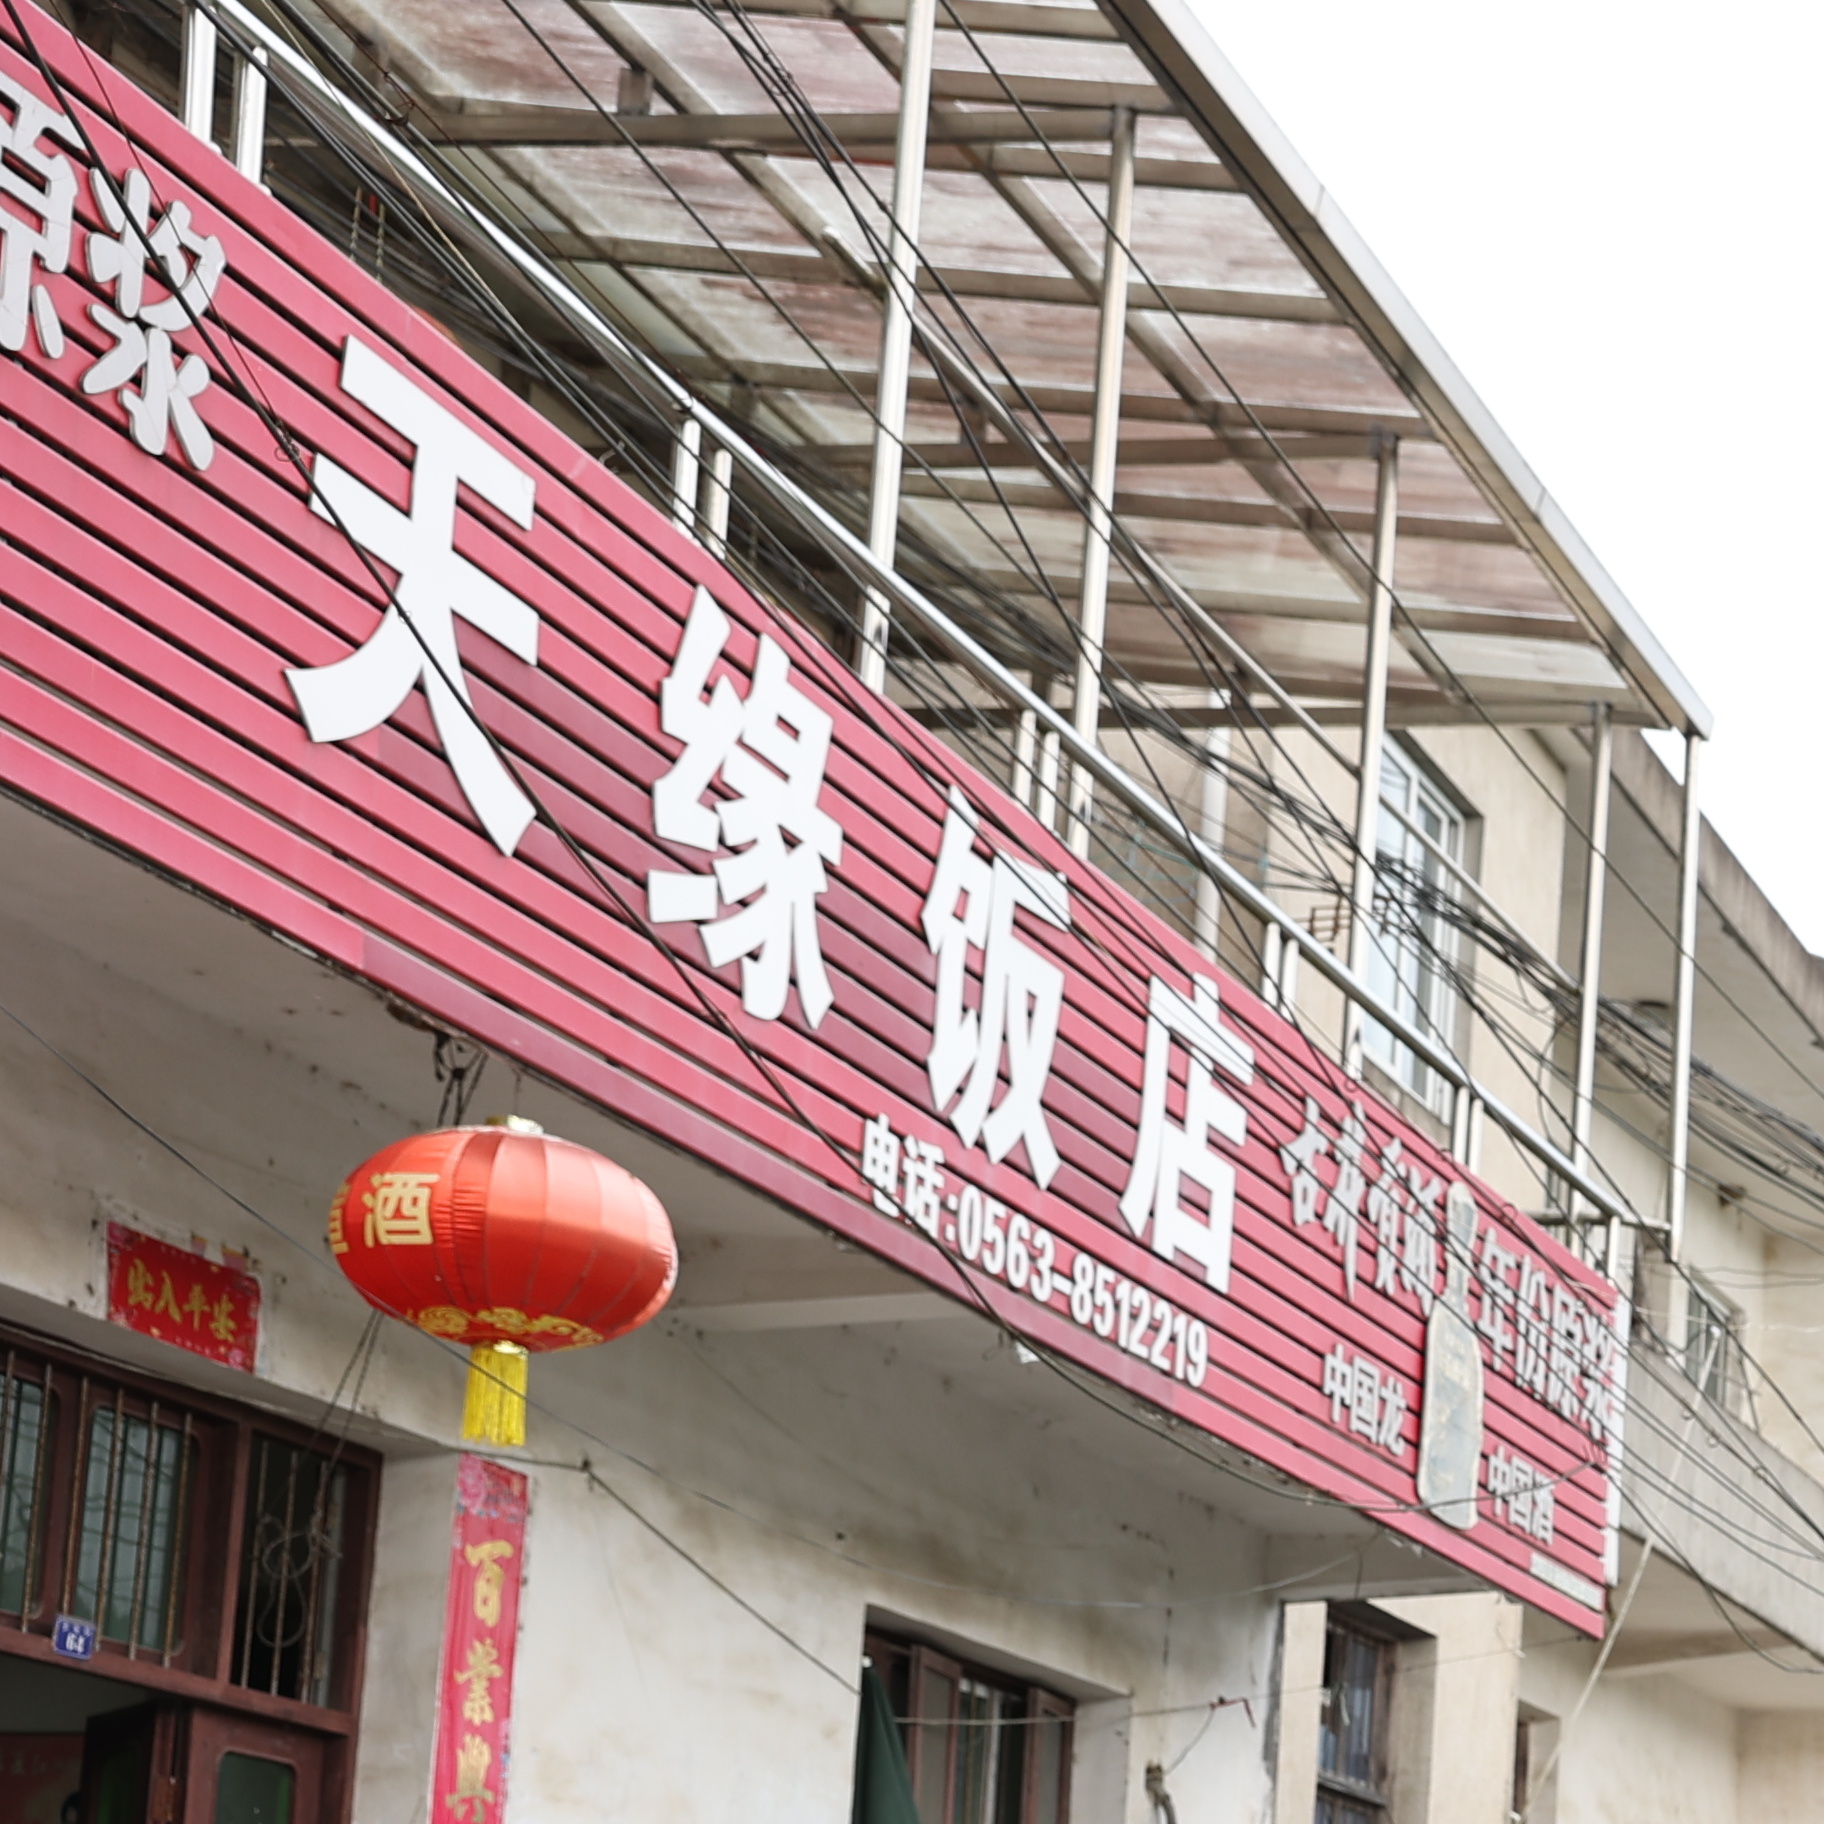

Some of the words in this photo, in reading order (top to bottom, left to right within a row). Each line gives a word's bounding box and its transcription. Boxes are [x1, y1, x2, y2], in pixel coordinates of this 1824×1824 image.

[284, 334, 1257, 1295] 天缘饭店
[362, 1172, 440, 1249] 酒
[127, 1258, 237, 1343] 出入平安
